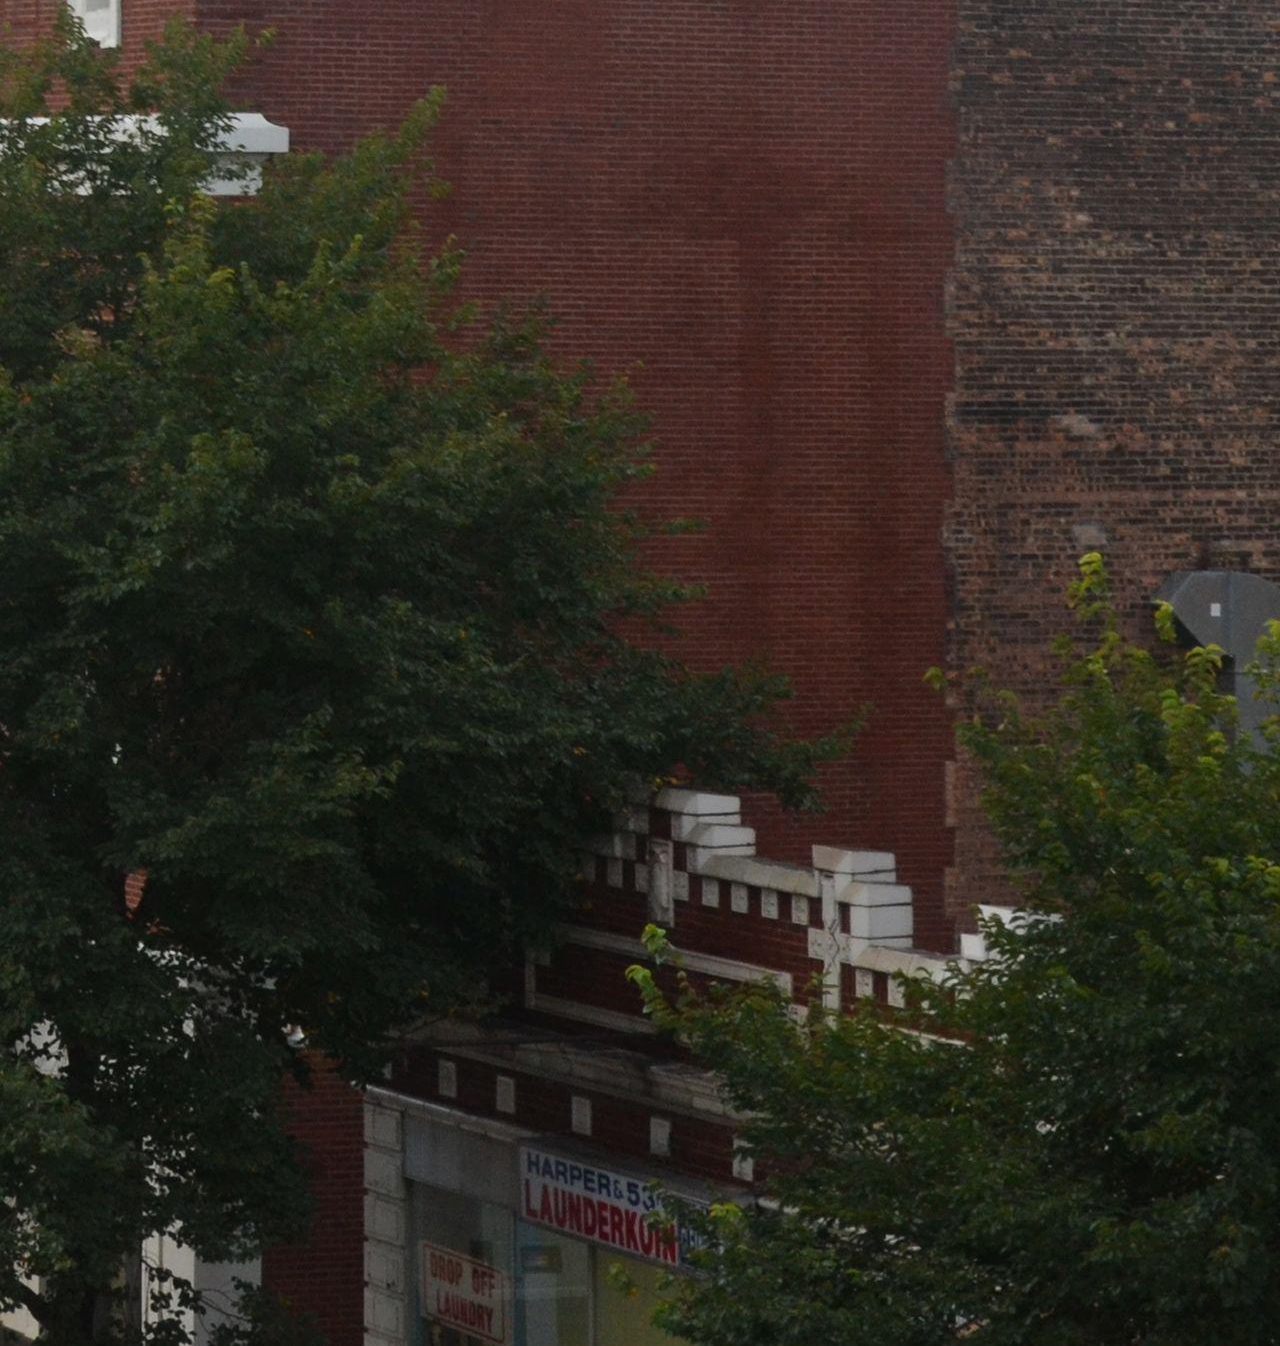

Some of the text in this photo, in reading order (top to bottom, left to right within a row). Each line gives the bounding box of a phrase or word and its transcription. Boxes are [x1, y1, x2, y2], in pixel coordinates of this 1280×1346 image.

[525, 1150, 612, 1198] HARPER
[613, 1180, 625, 1201] &
[524, 1181, 678, 1267] LAUNDERKOIN
[429, 1250, 496, 1301] DROP OFF
[435, 1289, 495, 1333] LAUNDRY
